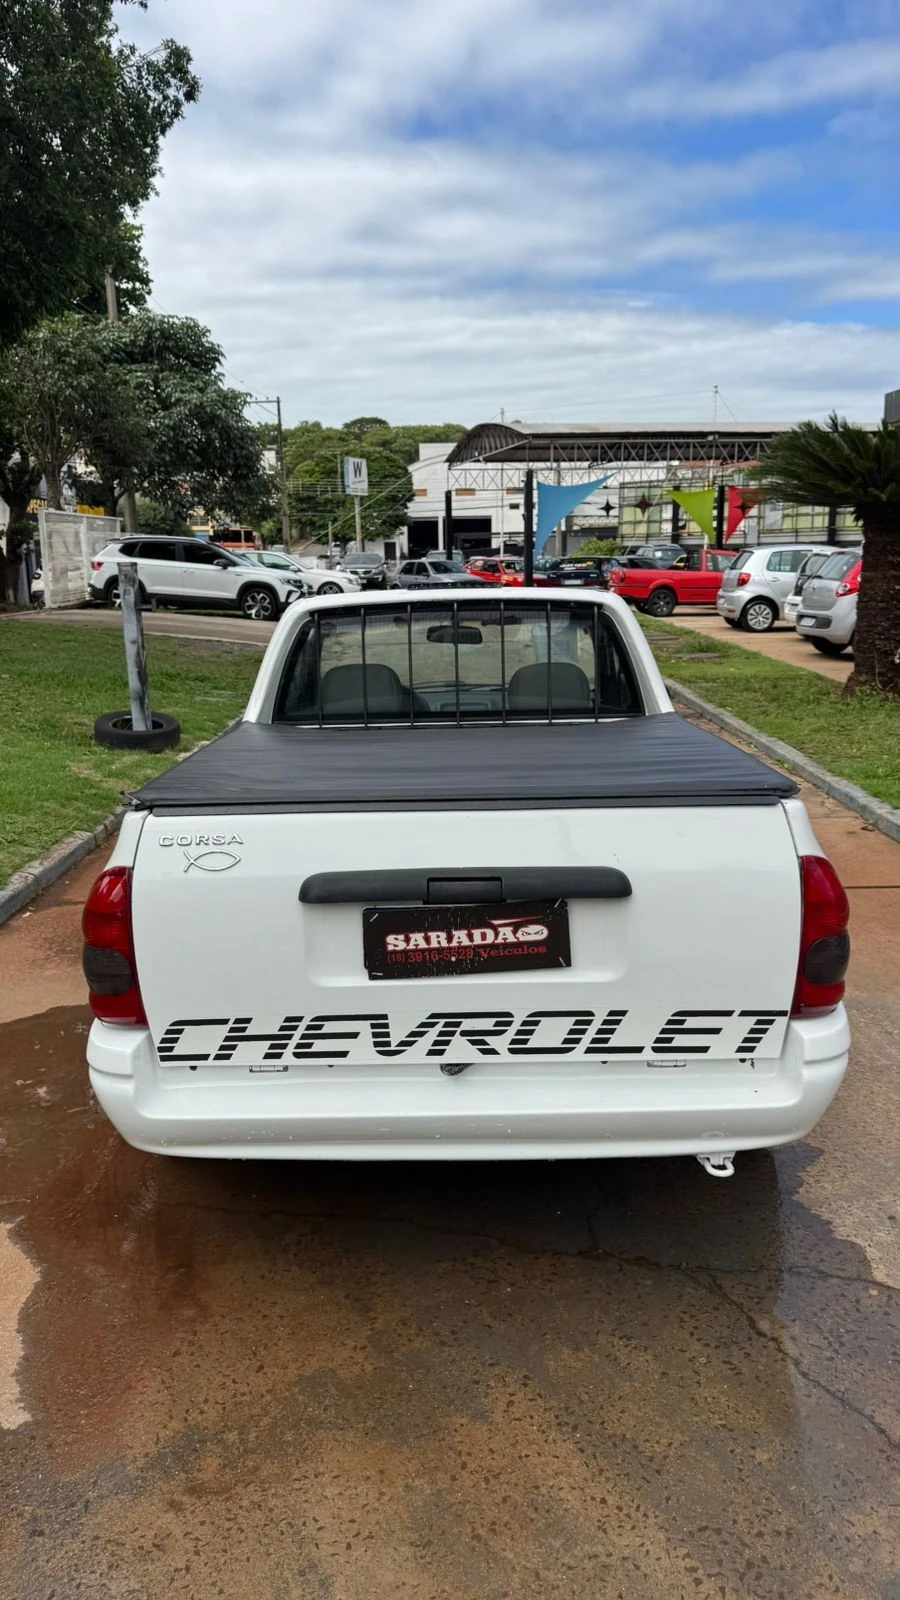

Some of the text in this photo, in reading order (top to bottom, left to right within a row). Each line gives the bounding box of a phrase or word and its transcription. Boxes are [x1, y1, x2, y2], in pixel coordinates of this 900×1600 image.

[353, 461, 362, 478] W
[158, 833, 244, 847] CORSA
[157, 1010, 788, 1062] CHEVROLET
